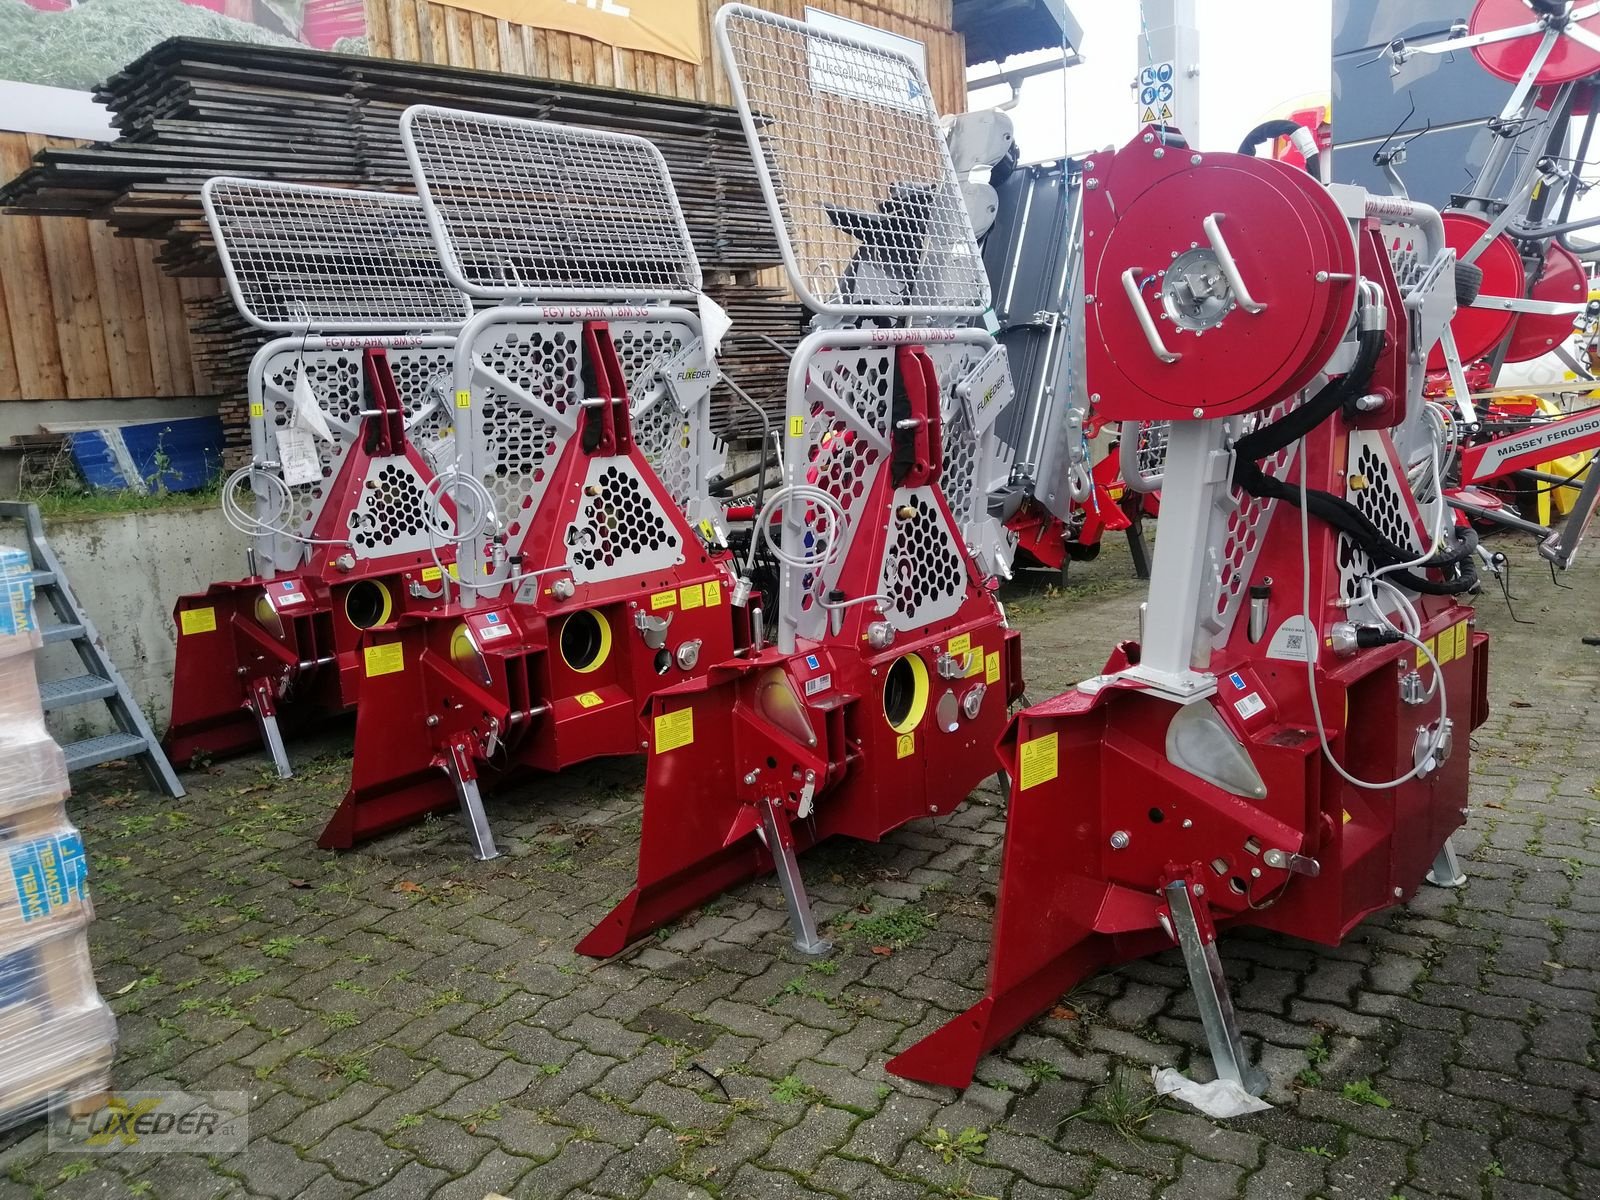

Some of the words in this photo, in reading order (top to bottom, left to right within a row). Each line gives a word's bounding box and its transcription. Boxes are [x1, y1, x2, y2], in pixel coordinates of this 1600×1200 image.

[543, 307, 565, 318] EGV
[585, 306, 606, 318] AHK
[636, 306, 649, 317] SG
[871, 329, 890, 342] EGV
[905, 329, 922, 341] AHK
[944, 328, 956, 340] SG
[325, 338, 346, 348] EGV
[349, 338, 361, 347] 65
[364, 337, 384, 347] AHK
[410, 336, 423, 346] SG
[1497, 437, 1543, 456] MASSEY
[1547, 420, 1600, 442] FERGUSO
